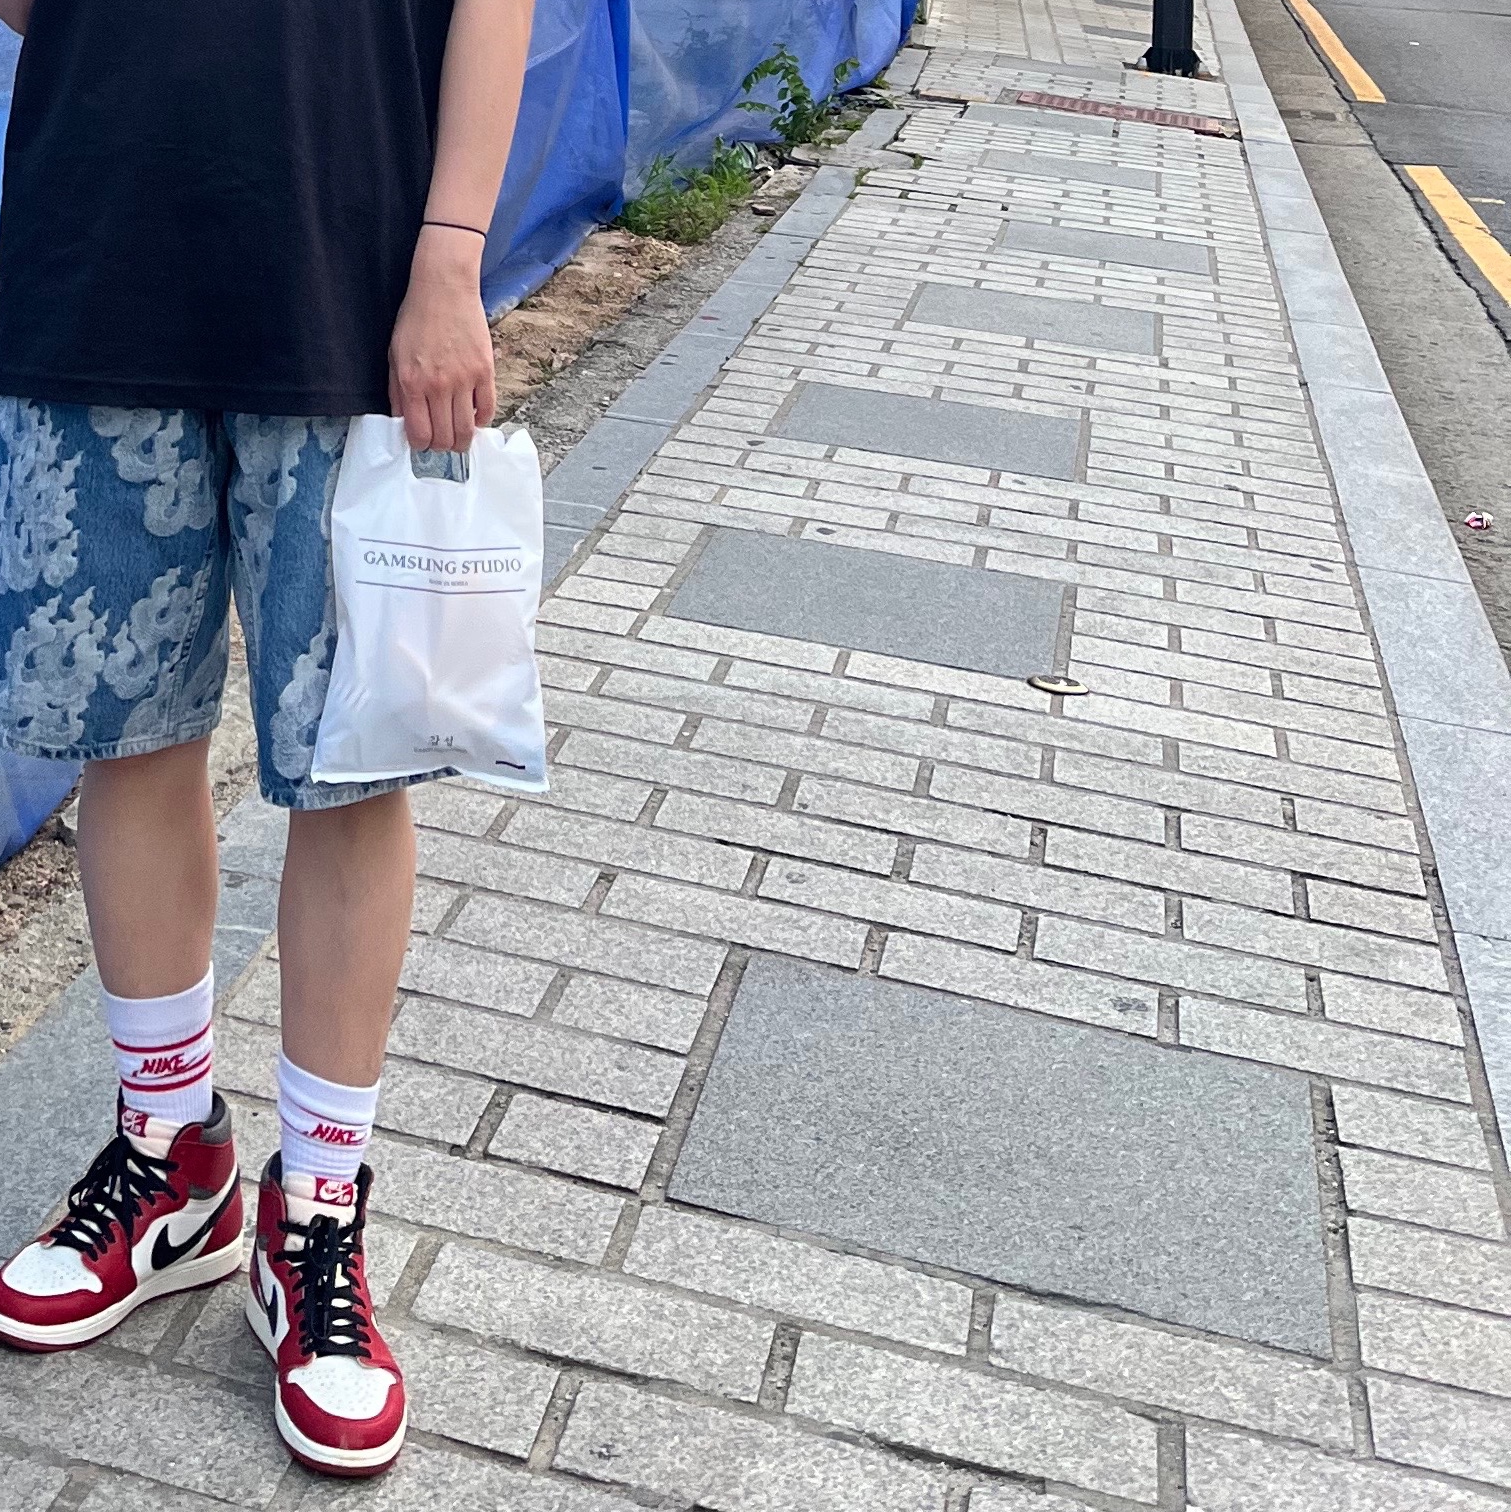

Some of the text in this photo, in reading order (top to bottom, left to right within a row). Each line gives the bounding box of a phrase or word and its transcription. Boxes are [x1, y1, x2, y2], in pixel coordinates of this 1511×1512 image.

[363, 550, 522, 575] GAMSUNG STUDIO
[139, 1052, 185, 1075] NIKE
[310, 1123, 357, 1144] NIKE
